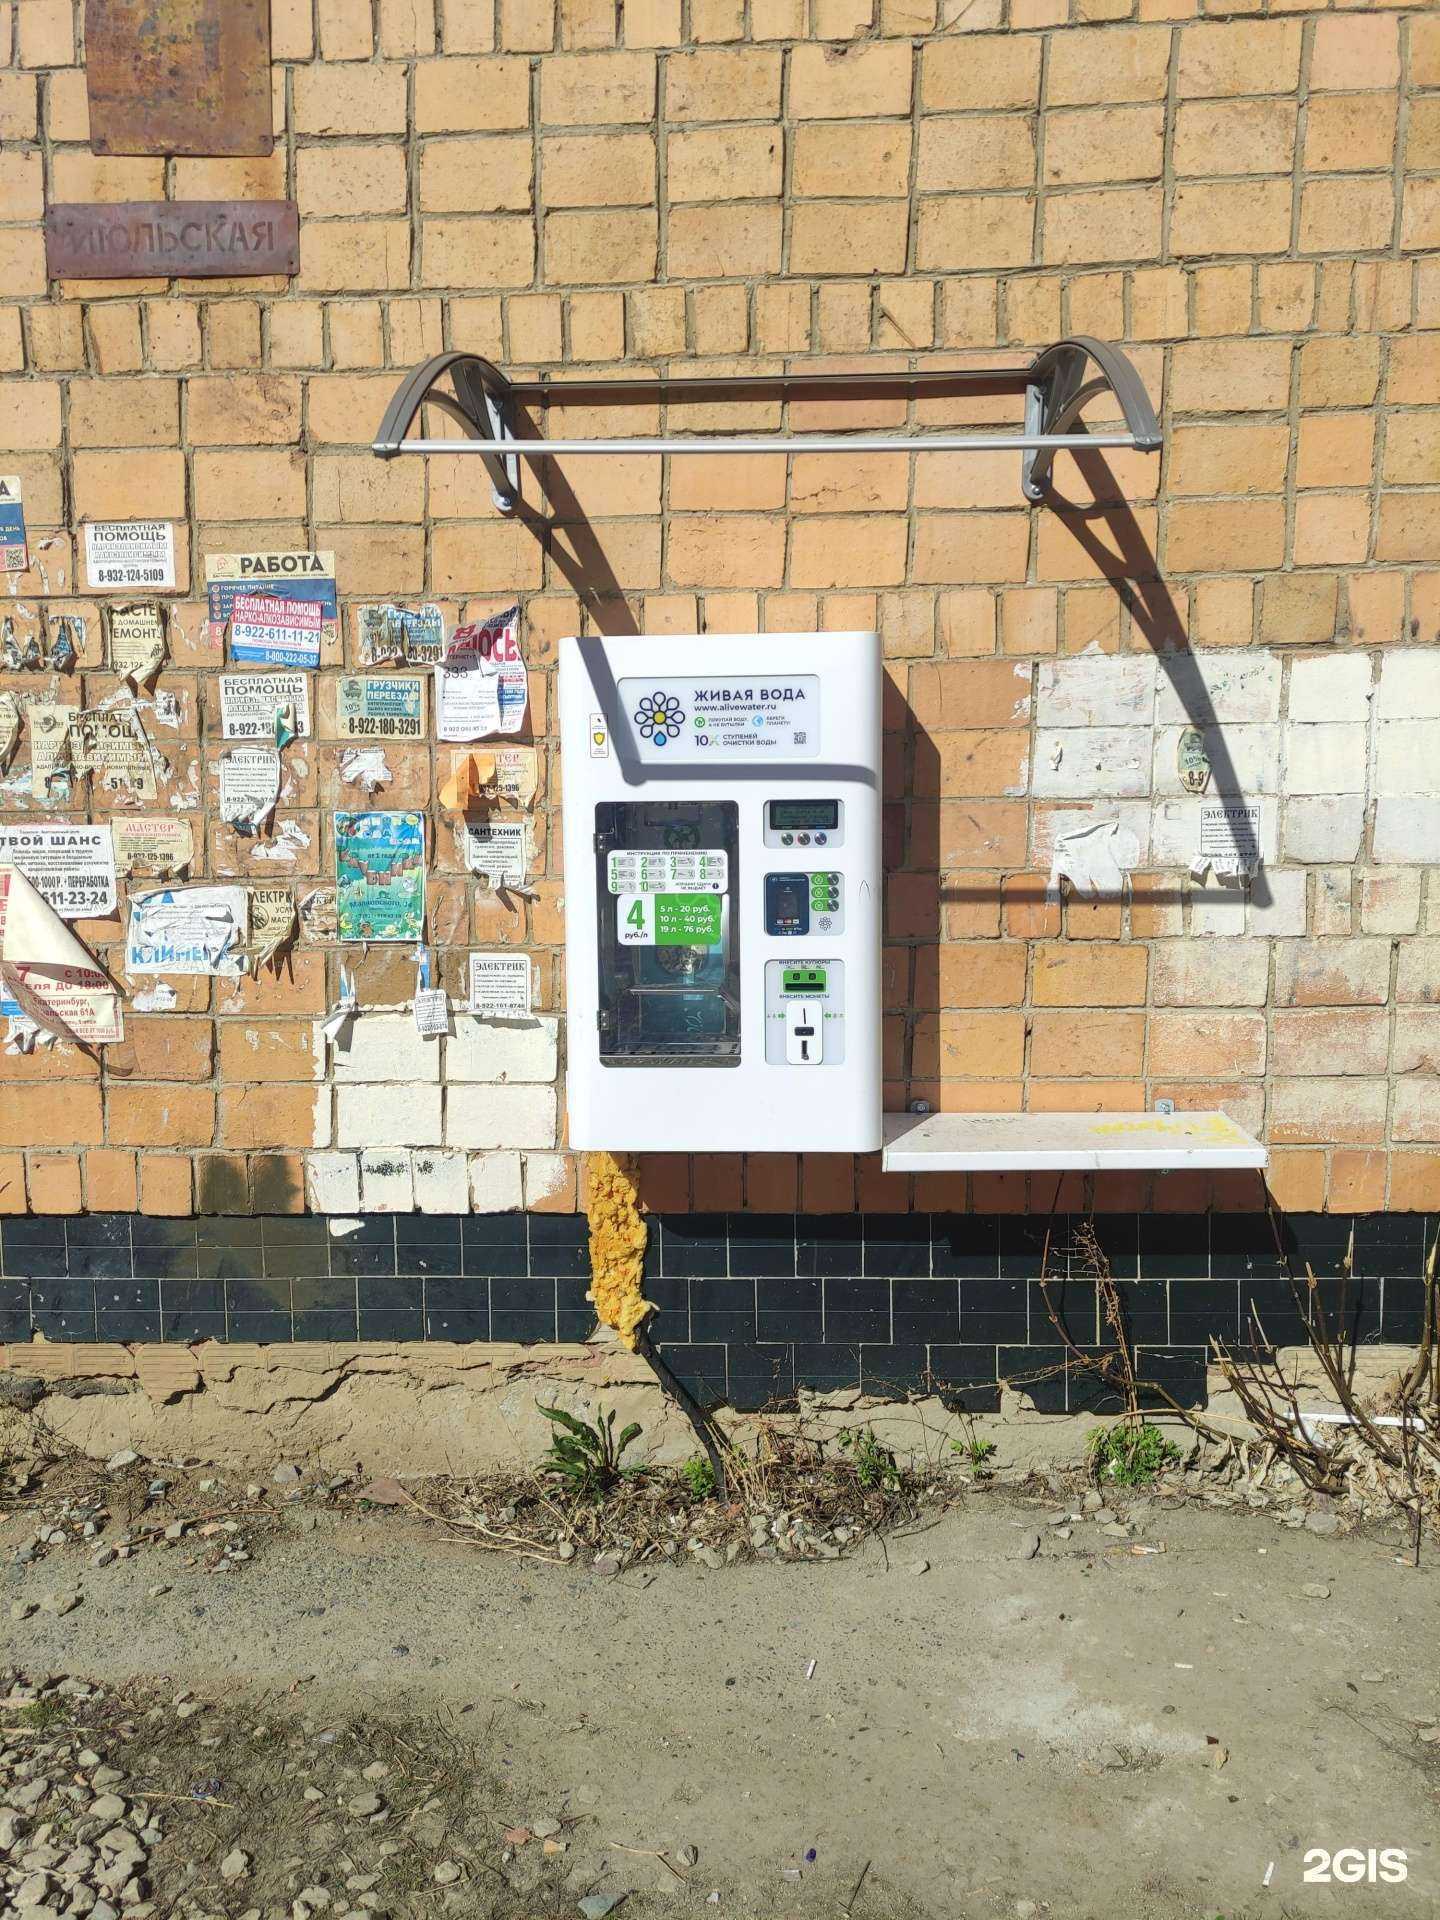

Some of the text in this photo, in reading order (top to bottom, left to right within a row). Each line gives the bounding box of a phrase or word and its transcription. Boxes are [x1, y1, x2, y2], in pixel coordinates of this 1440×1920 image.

[94, 524, 166, 532] БЕСПЛАТНАЯ
[93, 531, 166, 542] ПОМОЩЬ
[240, 555, 325, 574] РАБОТА
[98, 569, 164, 582] 8-932-124-5109
[235, 596, 321, 617] БЕСПЛАТНАЯ ПОМОЩЬ
[234, 625, 320, 643] 8-922-611-11-21
[224, 676, 303, 686] БЕСПЛАТНАЯ
[367, 680, 419, 690] ГРУЗЧИКИ
[224, 684, 303, 696] ПОМОЩЬ
[694, 688, 806, 702] ЖИВАЯ ВОДА
[694, 703, 777, 712] www.alivewater.ru
[349, 717, 421, 735] 8-922-180-3291
[694, 734, 709, 746] 10
[1202, 808, 1258, 819] ЭЛЕКТРИК
[127, 823, 177, 833] МАСТЕР
[468, 828, 521, 836] САНТЕХНИК
[0, 834, 102, 846] ТВОЙ ШАНС
[611, 857, 706, 868] 1 2 3 4
[611, 868, 706, 880] 5 6 7 8
[67, 875, 110, 888] ПЕРЕРАБОТКА
[611, 881, 649, 892] 9 10
[626, 899, 645, 930] 4
[692, 905, 711, 914] руб.
[697, 914, 715, 923] руб.
[684, 925, 694, 933] 76
[696, 925, 714, 934] руб.
[624, 932, 648, 940] руб./л
[475, 962, 525, 971] ЭЛЕКТРИК
